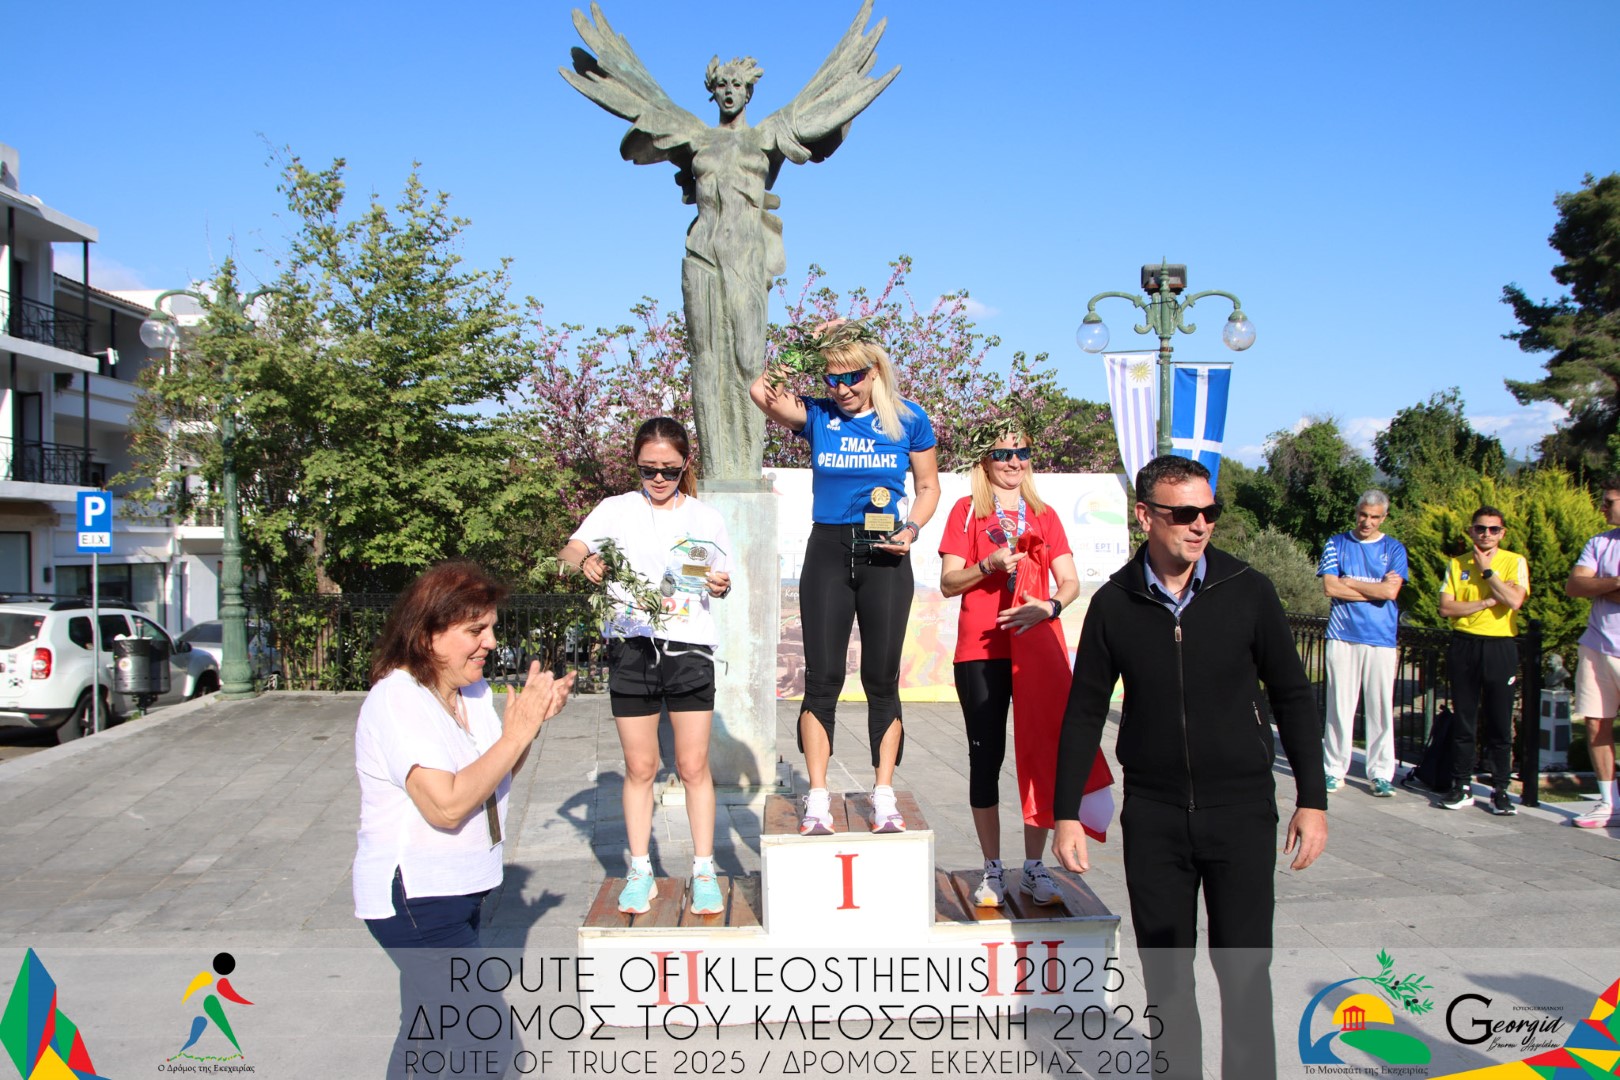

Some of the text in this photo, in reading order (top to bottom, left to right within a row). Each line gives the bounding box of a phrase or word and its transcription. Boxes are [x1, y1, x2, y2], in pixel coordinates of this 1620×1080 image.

[840, 437, 876, 453] ΣΜΑΧ
[818, 452, 897, 468] ΦΕΙΔΙΠΠΙΔΗΣ
[84, 496, 106, 527] P
[835, 853, 860, 910] I
